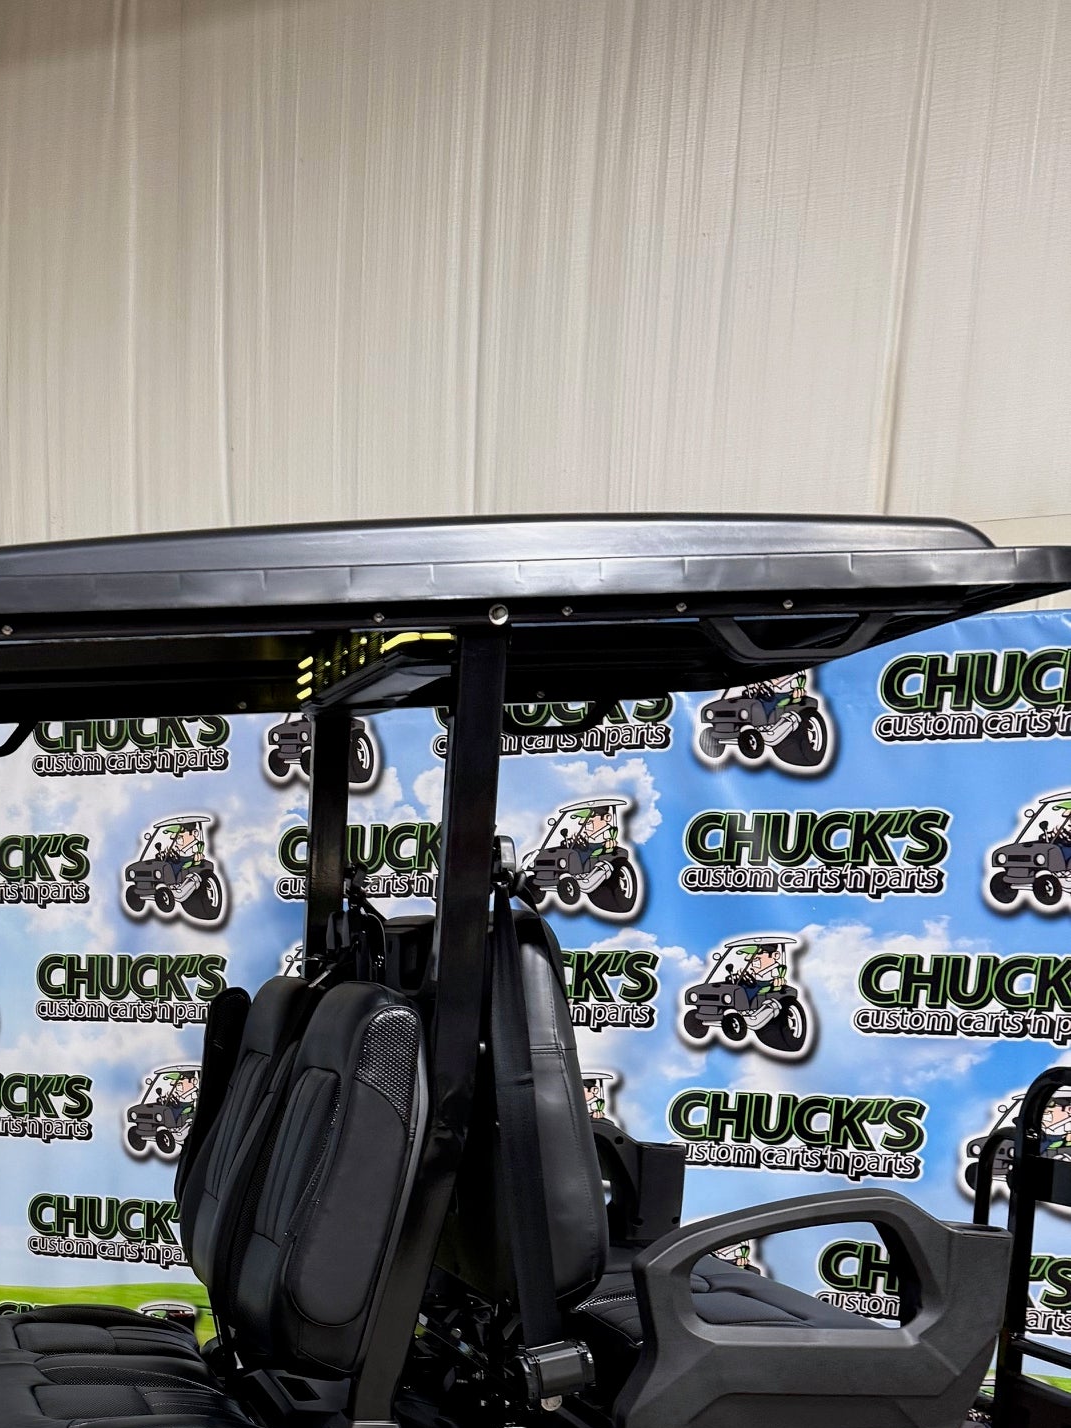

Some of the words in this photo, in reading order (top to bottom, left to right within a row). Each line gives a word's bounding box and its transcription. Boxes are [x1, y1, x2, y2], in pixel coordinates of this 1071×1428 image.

[881, 648, 1071, 713] CHUC
[604, 723, 668, 754] parts
[876, 710, 980, 740] custom
[32, 753, 104, 775] custom
[172, 748, 228, 776] parts
[685, 809, 950, 867] CHUCK'S
[38, 881, 89, 907] parts
[682, 866, 776, 890] custom
[869, 866, 942, 898] parts
[36, 954, 227, 1000] CHUCK'S
[858, 953, 1071, 1010] CHUCK
[36, 999, 107, 1022] custom
[590, 1003, 653, 1030] parts
[854, 1007, 956, 1034] custom
[42, 1119, 92, 1143] parts
[668, 1089, 926, 1152] CHUCK'S
[685, 1141, 758, 1167] ustom
[849, 1150, 920, 1180] parts
[28, 1236, 96, 1258] custom
